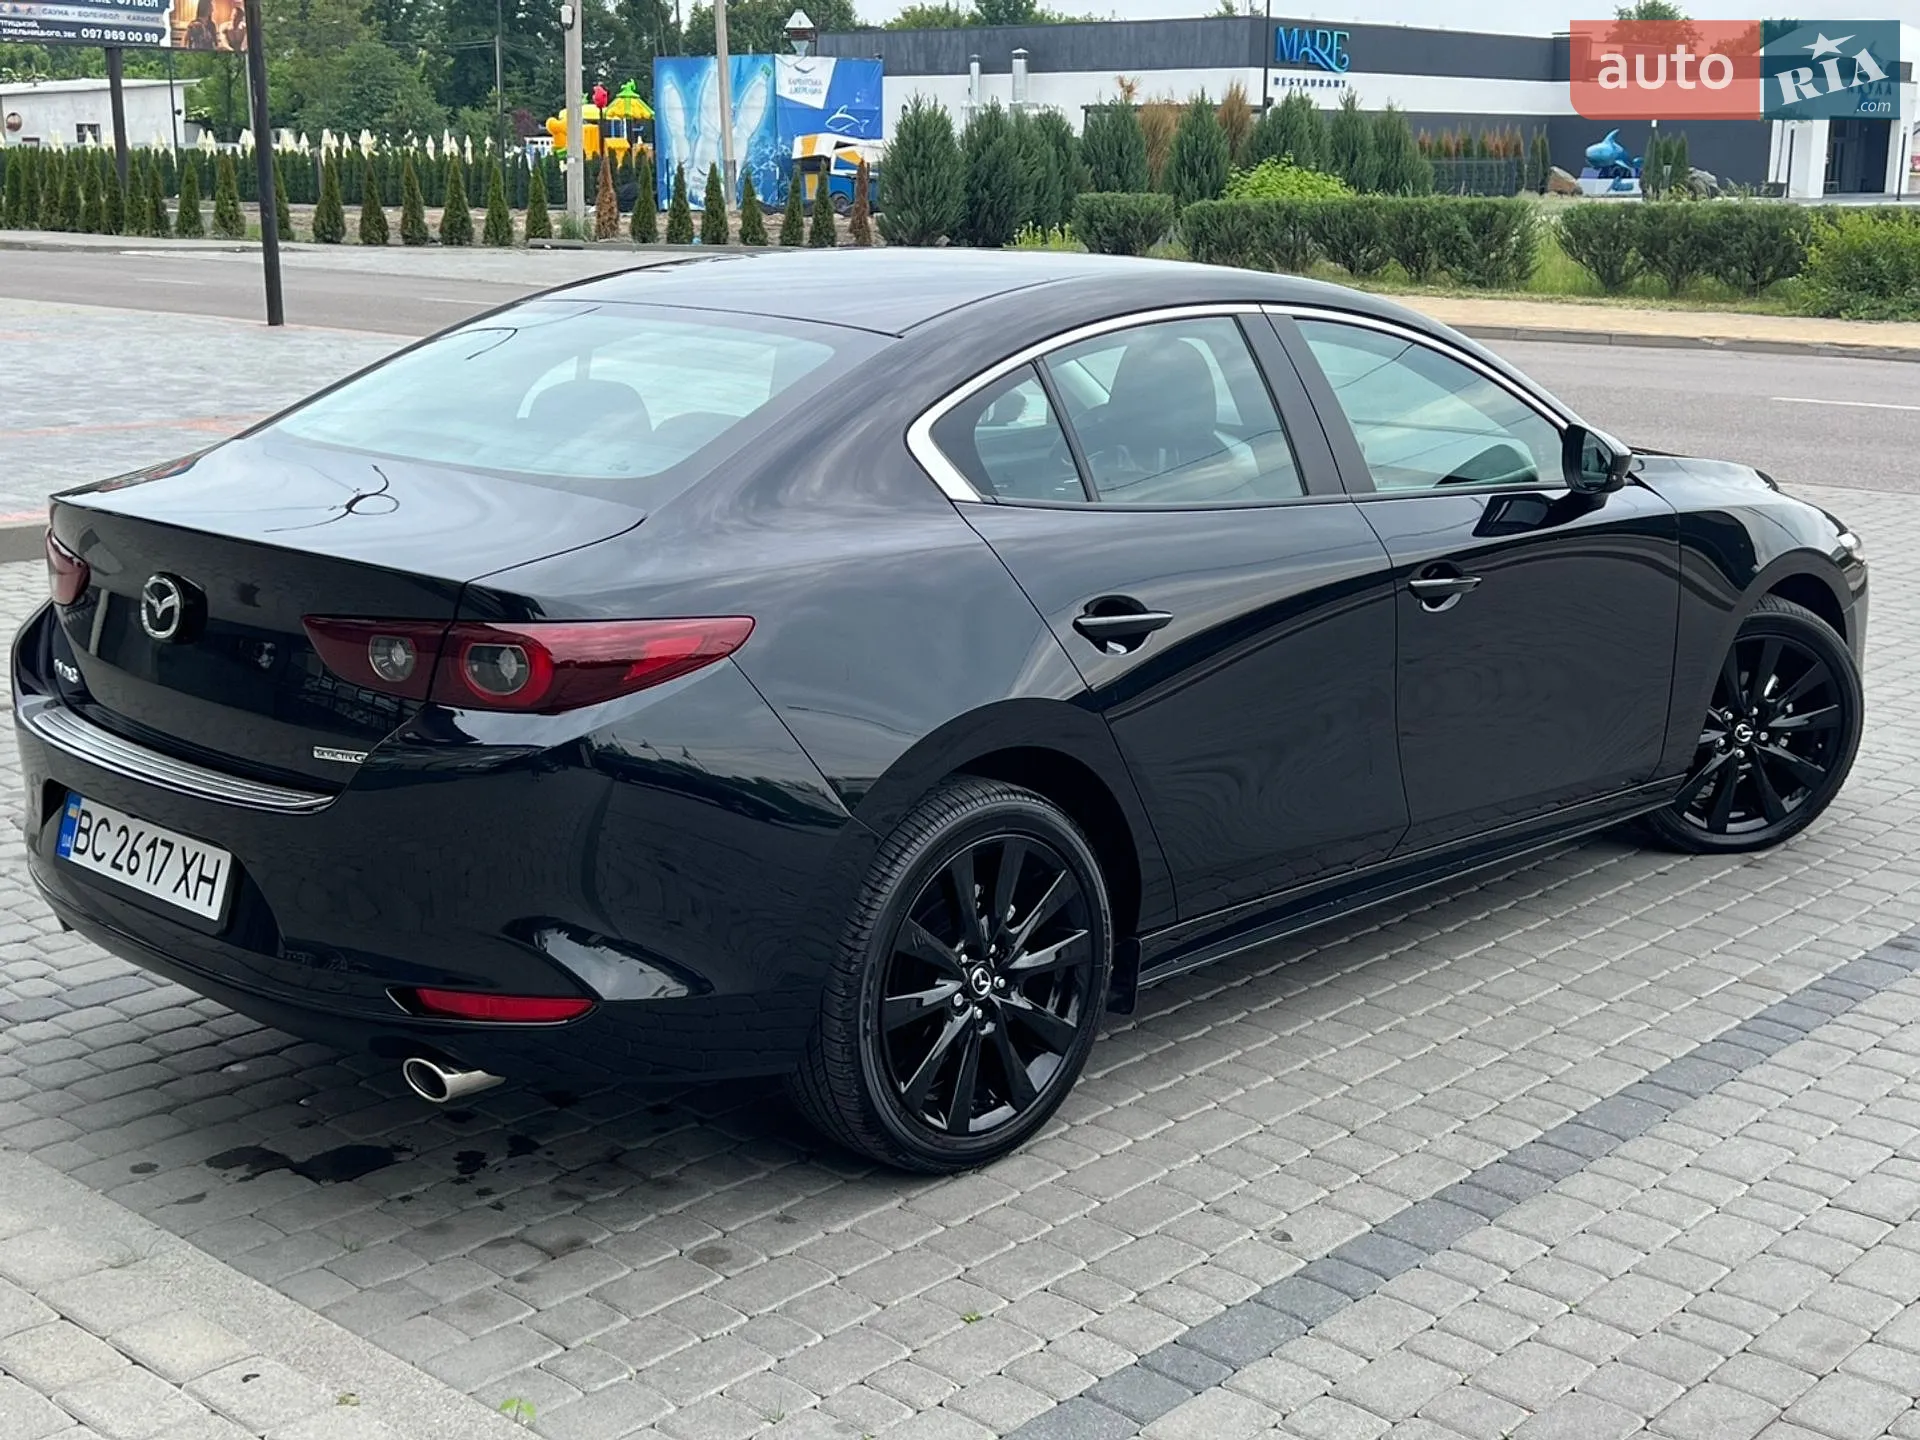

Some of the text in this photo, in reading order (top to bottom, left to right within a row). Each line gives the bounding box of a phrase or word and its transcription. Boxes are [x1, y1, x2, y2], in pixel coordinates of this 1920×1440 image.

[81, 27, 102, 39] 097
[127, 31, 143, 42] 00
[1275, 26, 1350, 73] MARE
[1273, 77, 1347, 88] RESTAURANT
[73, 809, 221, 907] BC 2617 XH
